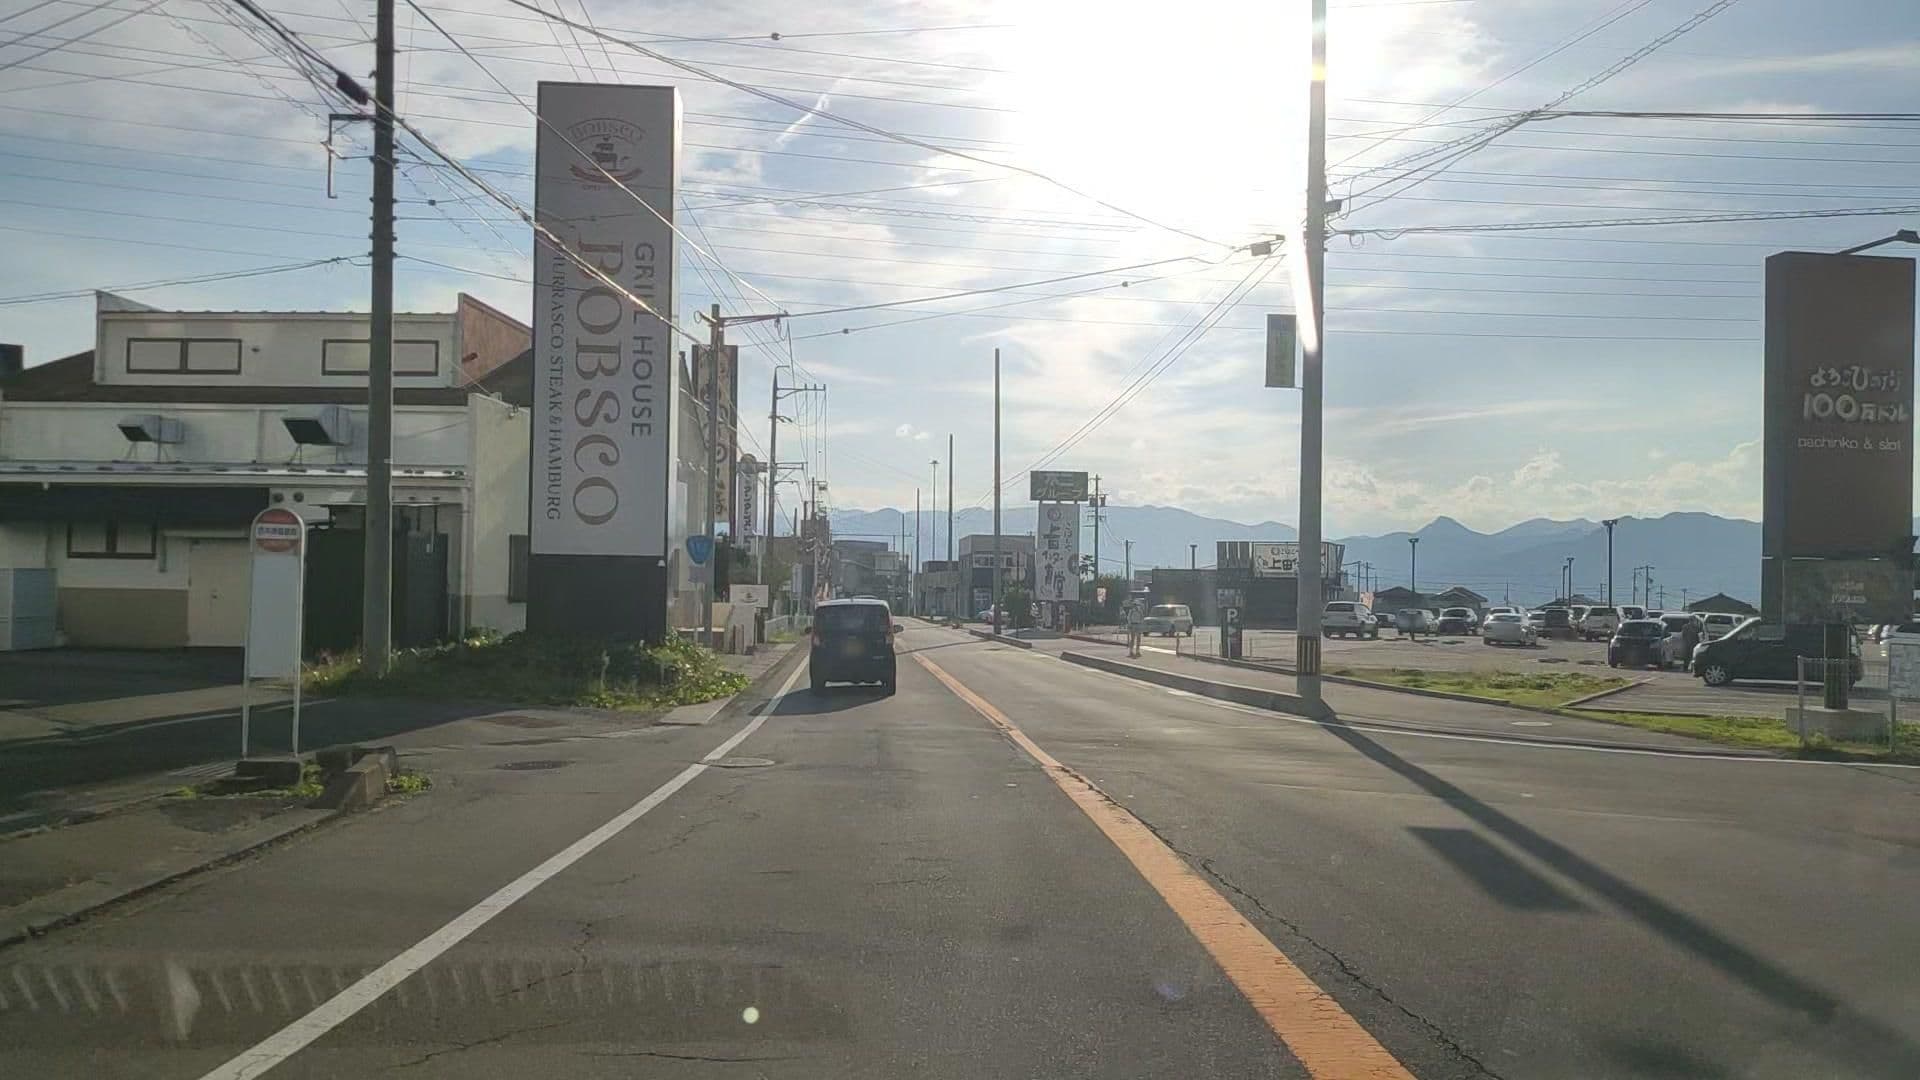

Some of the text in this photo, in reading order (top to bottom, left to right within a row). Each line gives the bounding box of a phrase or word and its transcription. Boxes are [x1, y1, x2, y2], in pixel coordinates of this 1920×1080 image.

[551, 240, 567, 349] URRASCO
[549, 354, 564, 416] STEAK
[573, 233, 624, 526] BOBSCO
[631, 336, 653, 437] HOUSE
[546, 428, 563, 521] HAMBURG
[1226, 608, 1239, 624] P
